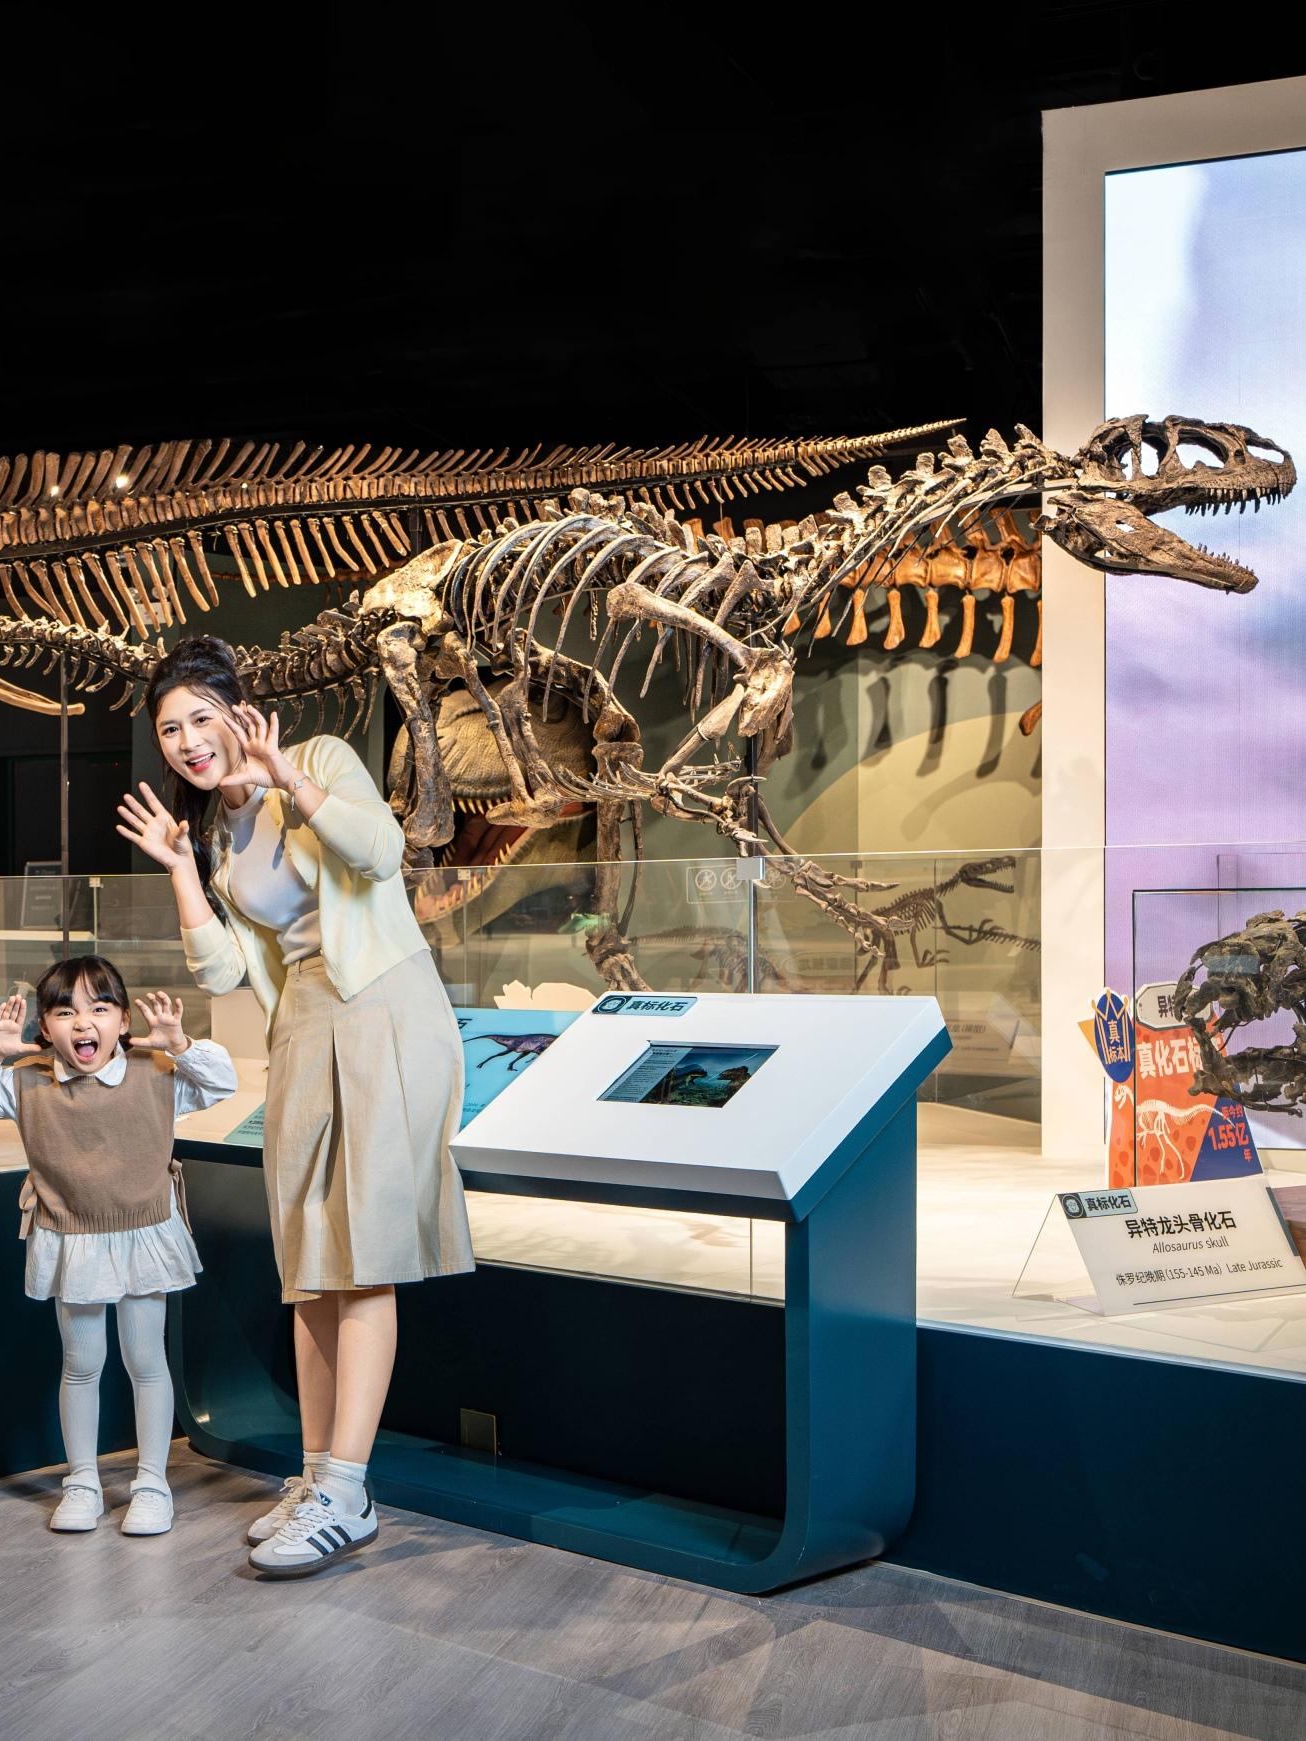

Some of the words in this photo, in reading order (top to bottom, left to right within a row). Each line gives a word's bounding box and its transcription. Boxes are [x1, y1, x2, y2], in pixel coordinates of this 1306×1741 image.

[626, 1001, 688, 1011] 真标化石
[1136, 1036, 1222, 1079] 真化石标
[1208, 1122, 1250, 1150] 1.55亿
[1085, 1194, 1132, 1212] 真标化石
[1125, 1210, 1237, 1239] 异特龙头骨化石
[1152, 1240, 1204, 1254] Allosaurus
[1205, 1235, 1230, 1249] skull
[1226, 1261, 1247, 1273] Late
[1247, 1257, 1284, 1271] Jurassic
